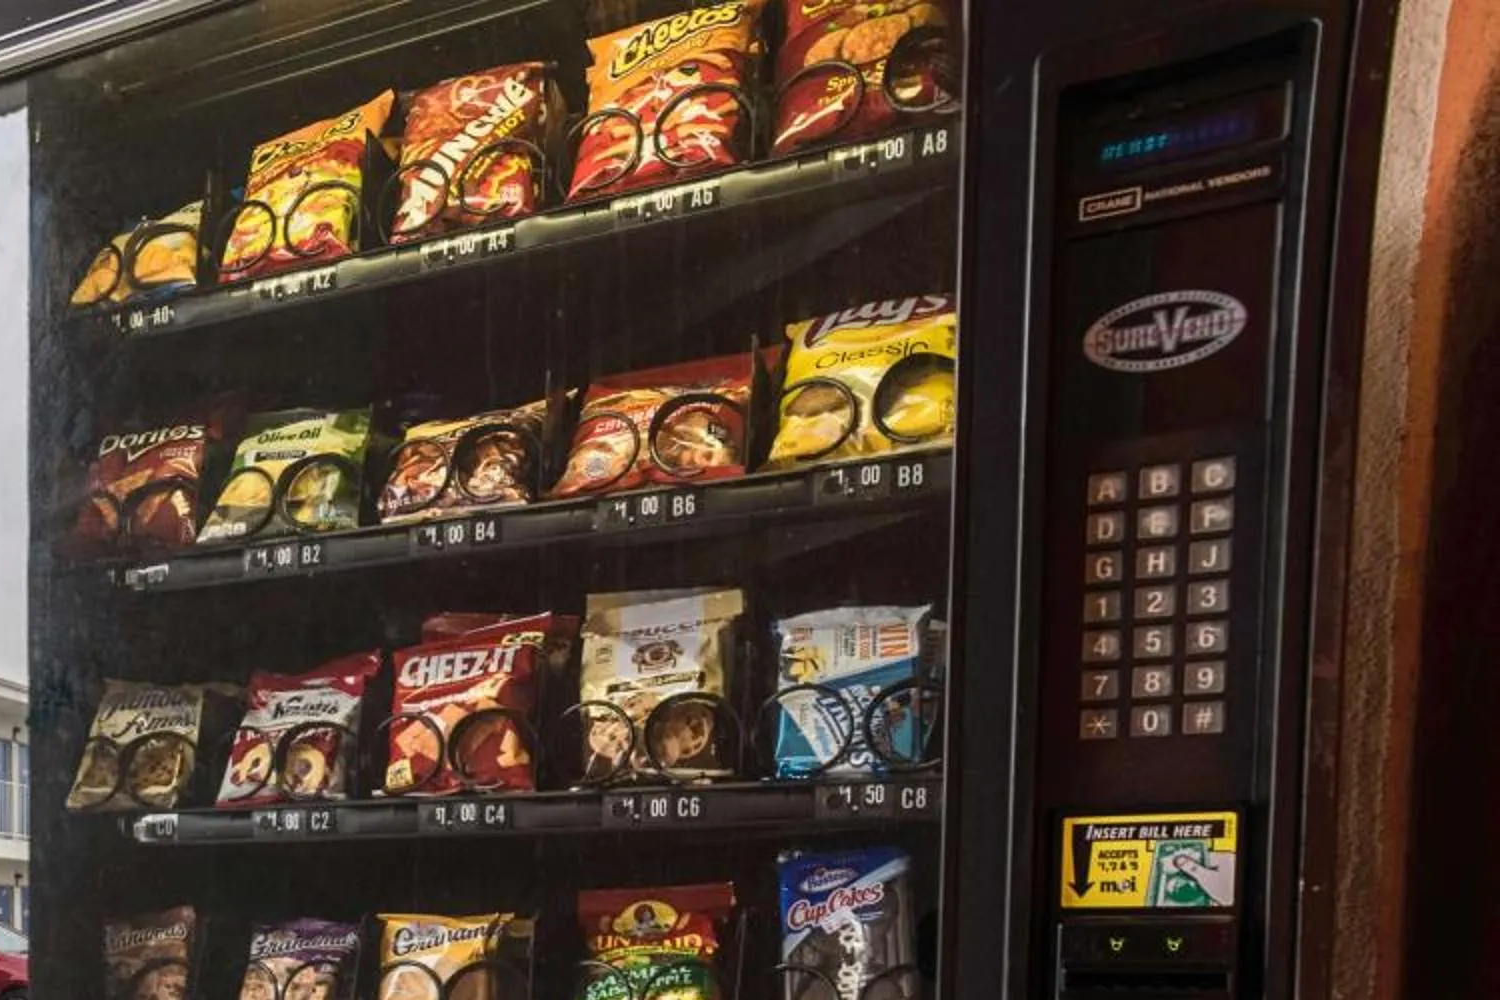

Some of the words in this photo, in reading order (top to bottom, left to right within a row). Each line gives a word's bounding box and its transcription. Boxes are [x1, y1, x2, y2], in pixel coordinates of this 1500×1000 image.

[613, 4, 743, 78] Cheetos
[495, 109, 526, 137] HOT
[921, 129, 949, 157] A8
[691, 188, 714, 208] A6
[1144, 181, 1204, 200] NATIONAL
[1086, 197, 1135, 215] CRANE
[487, 233, 508, 252] A4
[313, 271, 333, 291] A2
[815, 339, 929, 370] Classic
[257, 430, 296, 445] Olive
[298, 427, 322, 441] Oil
[897, 463, 924, 488] B8
[1151, 472, 1168, 494] B
[1204, 463, 1225, 487] C
[1097, 481, 1116, 500] A
[672, 494, 696, 517] B6
[475, 520, 497, 541] B4
[1097, 518, 1113, 540] D
[302, 544, 322, 564] B2
[1147, 552, 1165, 574] H
[1201, 545, 1218, 568] J
[1095, 557, 1113, 578] G
[1147, 591, 1164, 613] 2
[1200, 585, 1217, 608] 3
[1097, 598, 1107, 618] 1
[1093, 636, 1108, 656] 4
[1146, 630, 1162, 652] 5
[1199, 626, 1216, 648] 6
[398, 643, 522, 687] CHEEZ-IT
[1093, 675, 1108, 696] 7
[1143, 671, 1160, 692] 8
[1196, 667, 1214, 689] 9
[677, 795, 701, 819] C6
[900, 786, 927, 810] C8
[310, 810, 331, 831] C2
[484, 804, 506, 825] C4
[1085, 824, 1137, 841] INSERT
[1139, 825, 1169, 839] BILL
[1173, 823, 1214, 837] HERE
